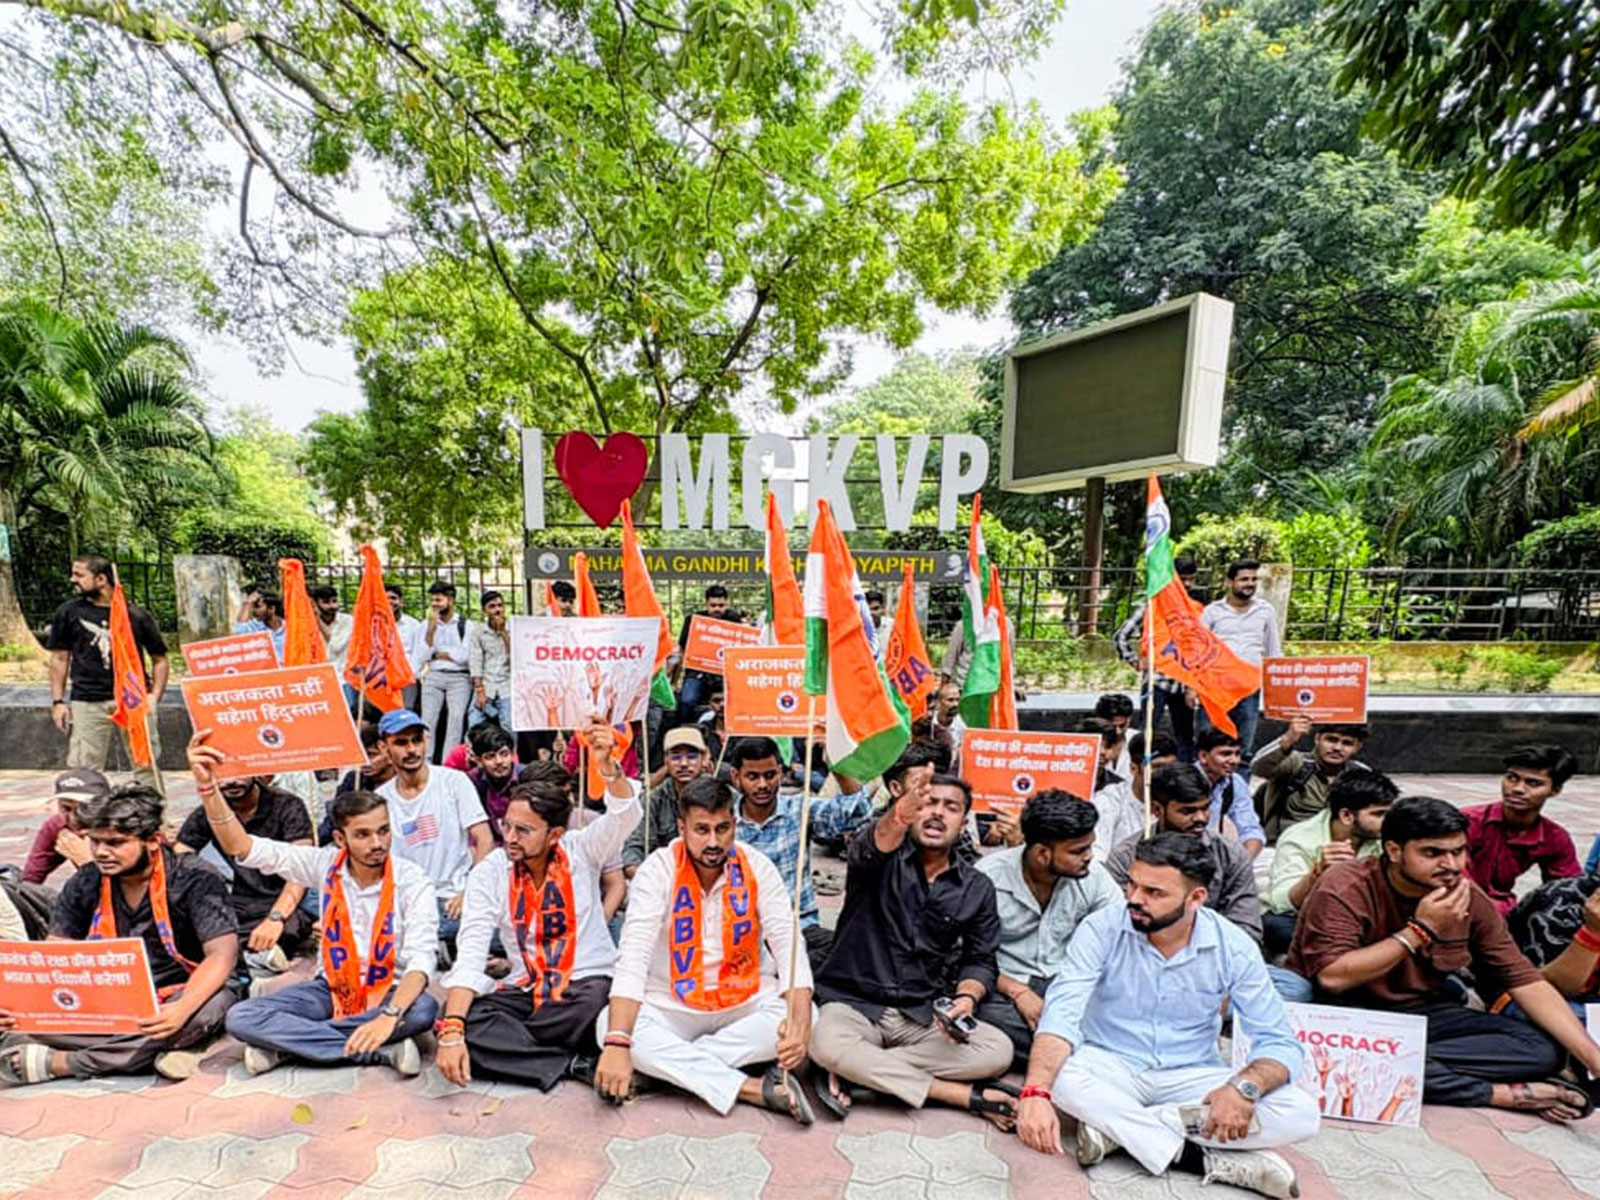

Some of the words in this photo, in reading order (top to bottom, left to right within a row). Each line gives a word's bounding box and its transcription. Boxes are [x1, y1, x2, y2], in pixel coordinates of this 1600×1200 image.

[521, 427, 546, 530] I
[660, 432, 990, 532] MGKVP
[672, 555, 749, 573] GANDHI
[535, 644, 645, 661] DEMOCRACY
[197, 684, 284, 706] अराजकता
[288, 675, 325, 697] नहीं
[746, 673, 783, 689] सहेगा
[216, 706, 257, 725] सहेगा
[260, 701, 330, 722] हिंदुस्तान
[672, 885, 696, 1003] ABVP
